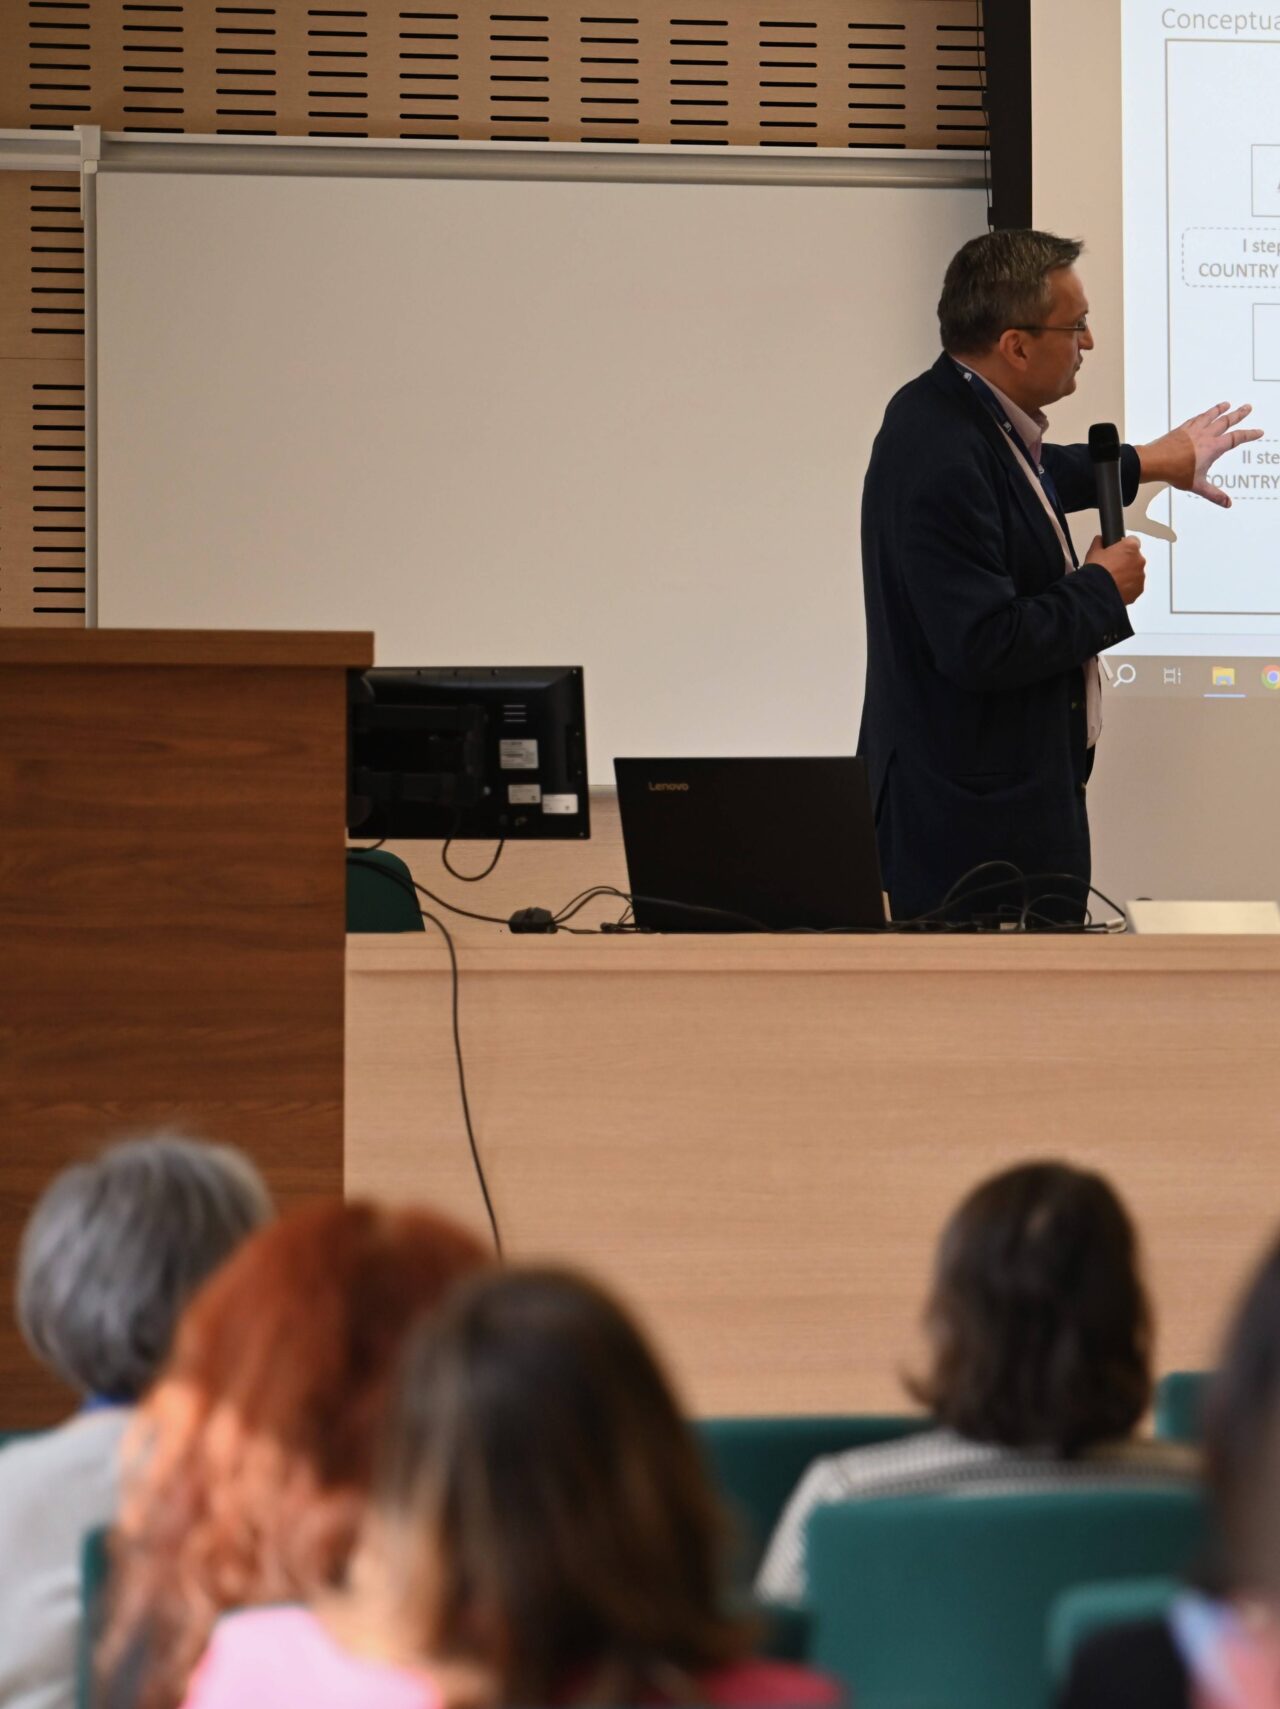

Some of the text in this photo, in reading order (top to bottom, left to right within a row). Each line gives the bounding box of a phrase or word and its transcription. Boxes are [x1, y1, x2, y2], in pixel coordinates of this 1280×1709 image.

[1198, 262, 1279, 278] COUNTRY
[1242, 450, 1252, 465] II
[1207, 474, 1280, 490] OUNTRY
[648, 781, 690, 792] Lenovo
